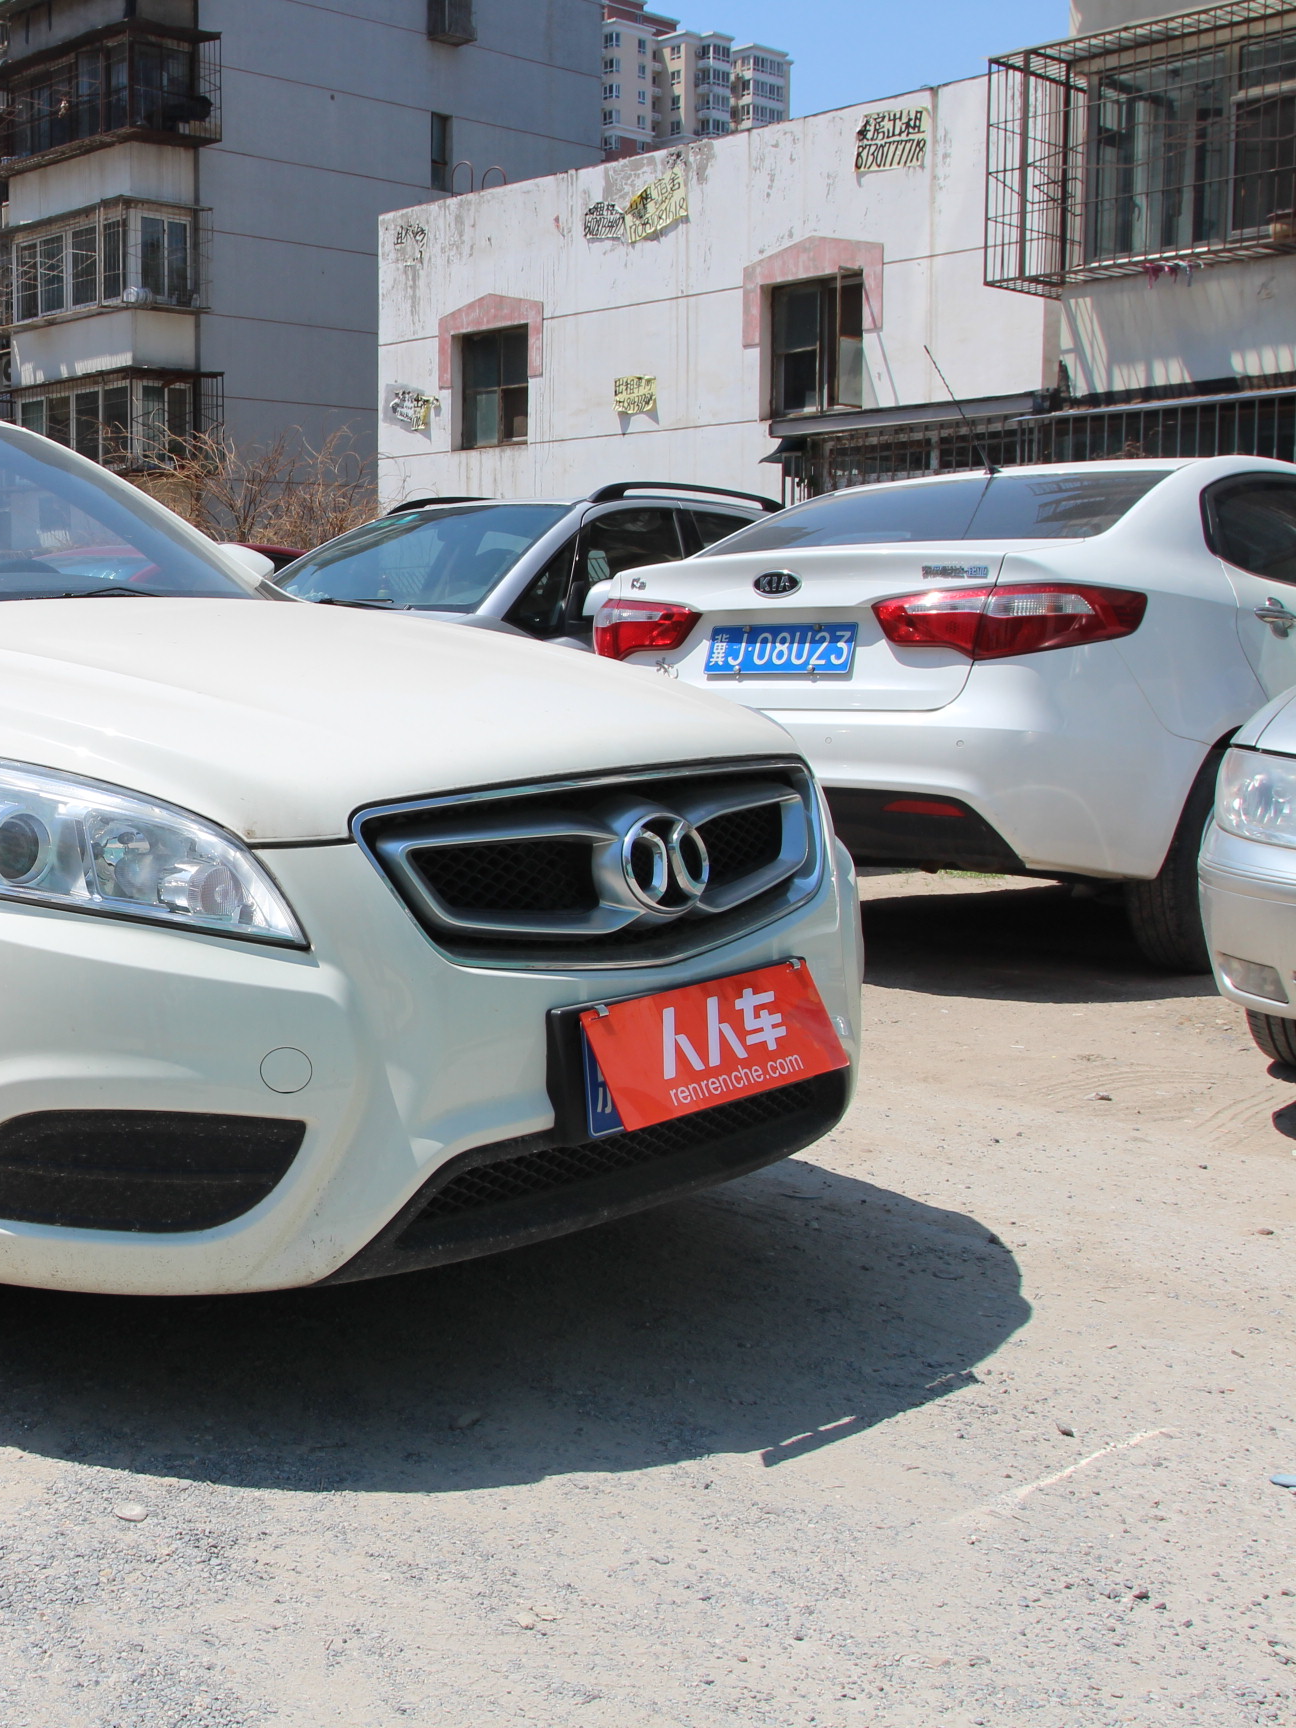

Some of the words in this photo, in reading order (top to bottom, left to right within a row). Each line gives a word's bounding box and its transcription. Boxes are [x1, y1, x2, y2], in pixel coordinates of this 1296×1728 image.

[759, 576, 791, 592] KIA
[662, 987, 787, 1080] 人人车
[669, 1053, 804, 1106] renrenche.com
